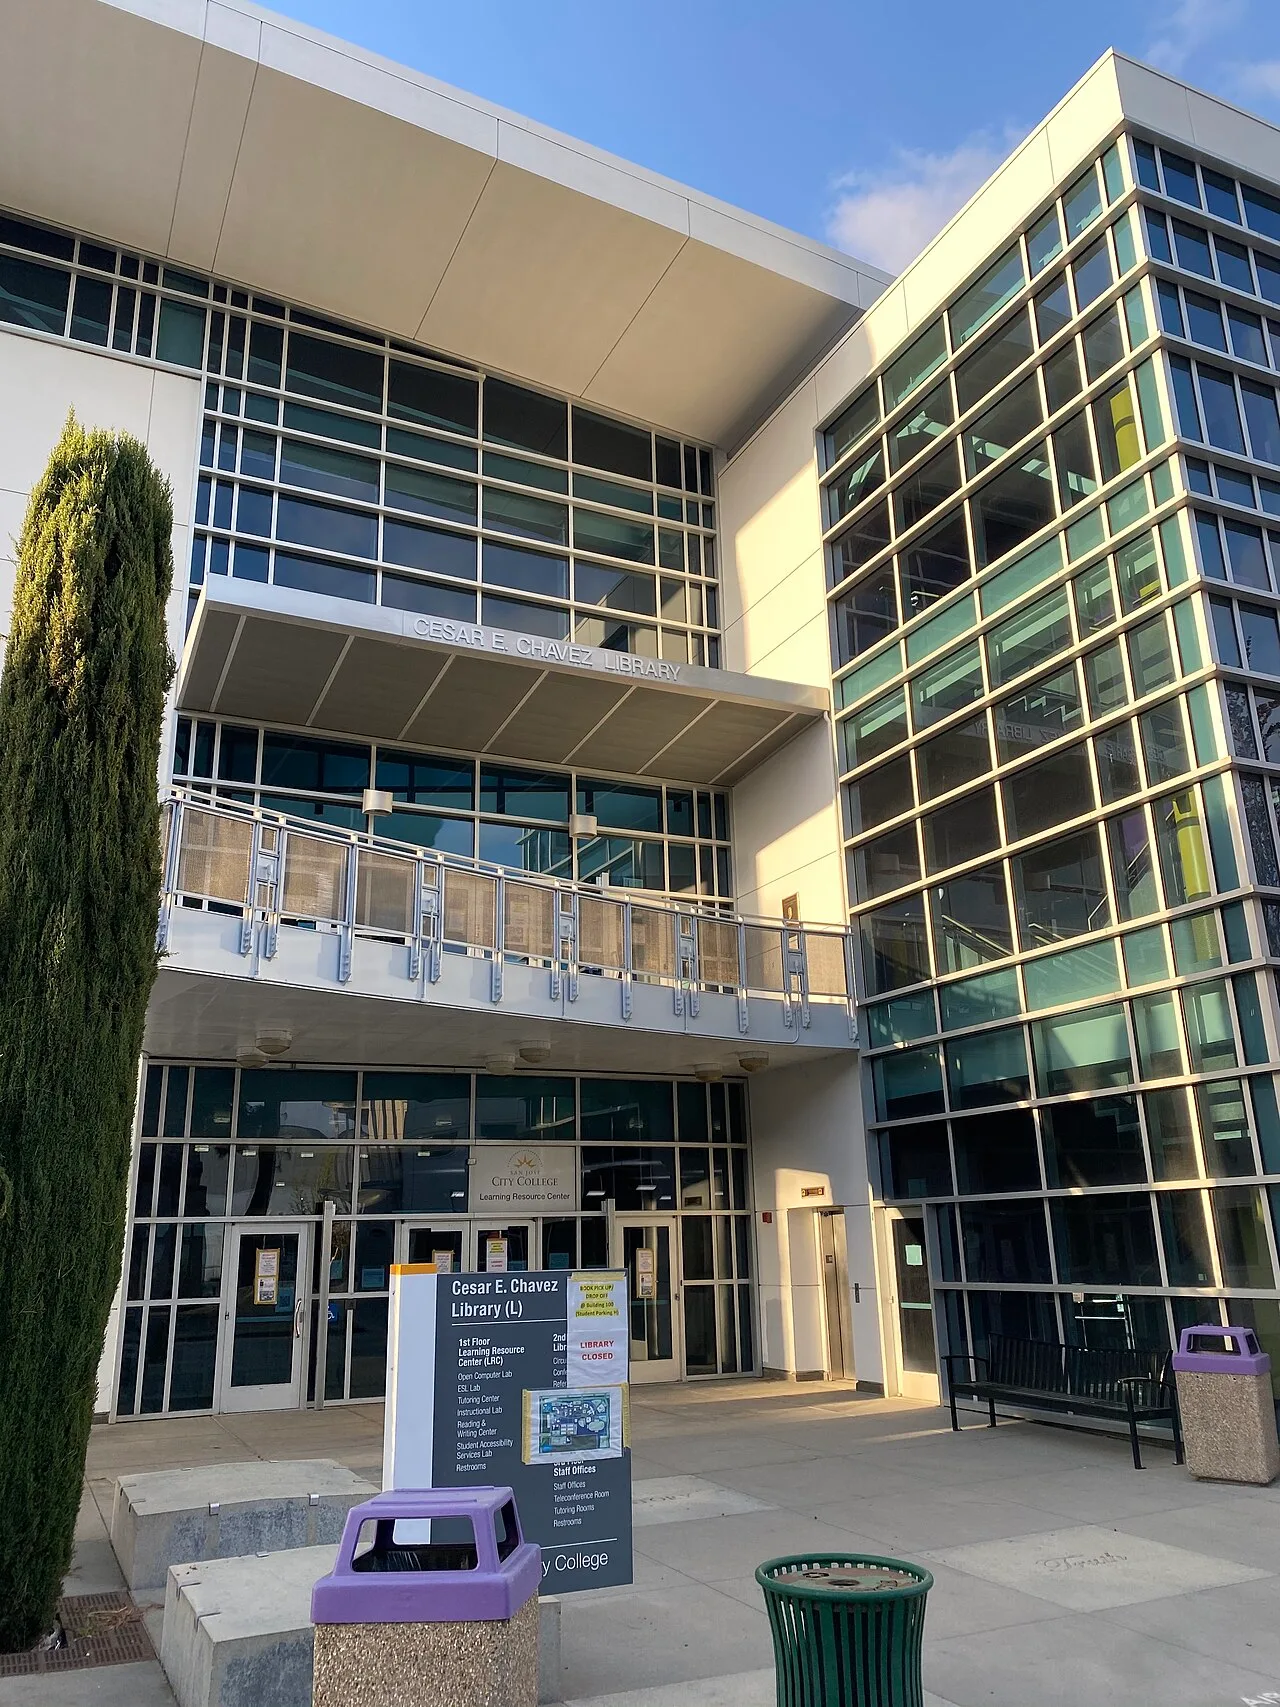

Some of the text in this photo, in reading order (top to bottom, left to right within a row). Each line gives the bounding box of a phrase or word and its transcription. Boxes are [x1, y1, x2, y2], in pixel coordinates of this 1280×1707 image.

[413, 618, 681, 681] CESAR E. CHAVEZ LIBRARY
[492, 1176, 558, 1187] CITY COLLEGE
[479, 1193, 511, 1201] Learning
[547, 1192, 570, 1200] Center
[452, 1278, 559, 1296] Cesar E. Chavez
[451, 1300, 523, 1319] Library (L)
[458, 1337, 490, 1347] 1st Floor
[553, 1333, 566, 1342] 2nd
[553, 1343, 567, 1352] Libr
[580, 1340, 615, 1349] LIBRARY
[458, 1346, 525, 1357] Learning Resource
[581, 1352, 613, 1361] CLOSED
[458, 1356, 504, 1367] Center (LRC)
[457, 1370, 513, 1381] Open Computer Lab
[457, 1384, 481, 1393] ESL Lab
[457, 1394, 500, 1405] Tutoring Center
[457, 1406, 503, 1417] Instructional Lab
[457, 1419, 486, 1429] Reading &
[457, 1428, 497, 1438] Writing Center
[456, 1439, 514, 1451] Student Accessibility
[456, 1450, 493, 1460] Services Lab
[456, 1463, 487, 1472] Restrooms
[553, 1464, 596, 1477] Staff Offices
[553, 1480, 586, 1491] Staff Offices
[553, 1490, 610, 1503] Teleconference Room
[554, 1504, 595, 1515] Tutoring Rooms
[553, 1518, 582, 1528] Restrooms
[555, 1552, 609, 1571] College
